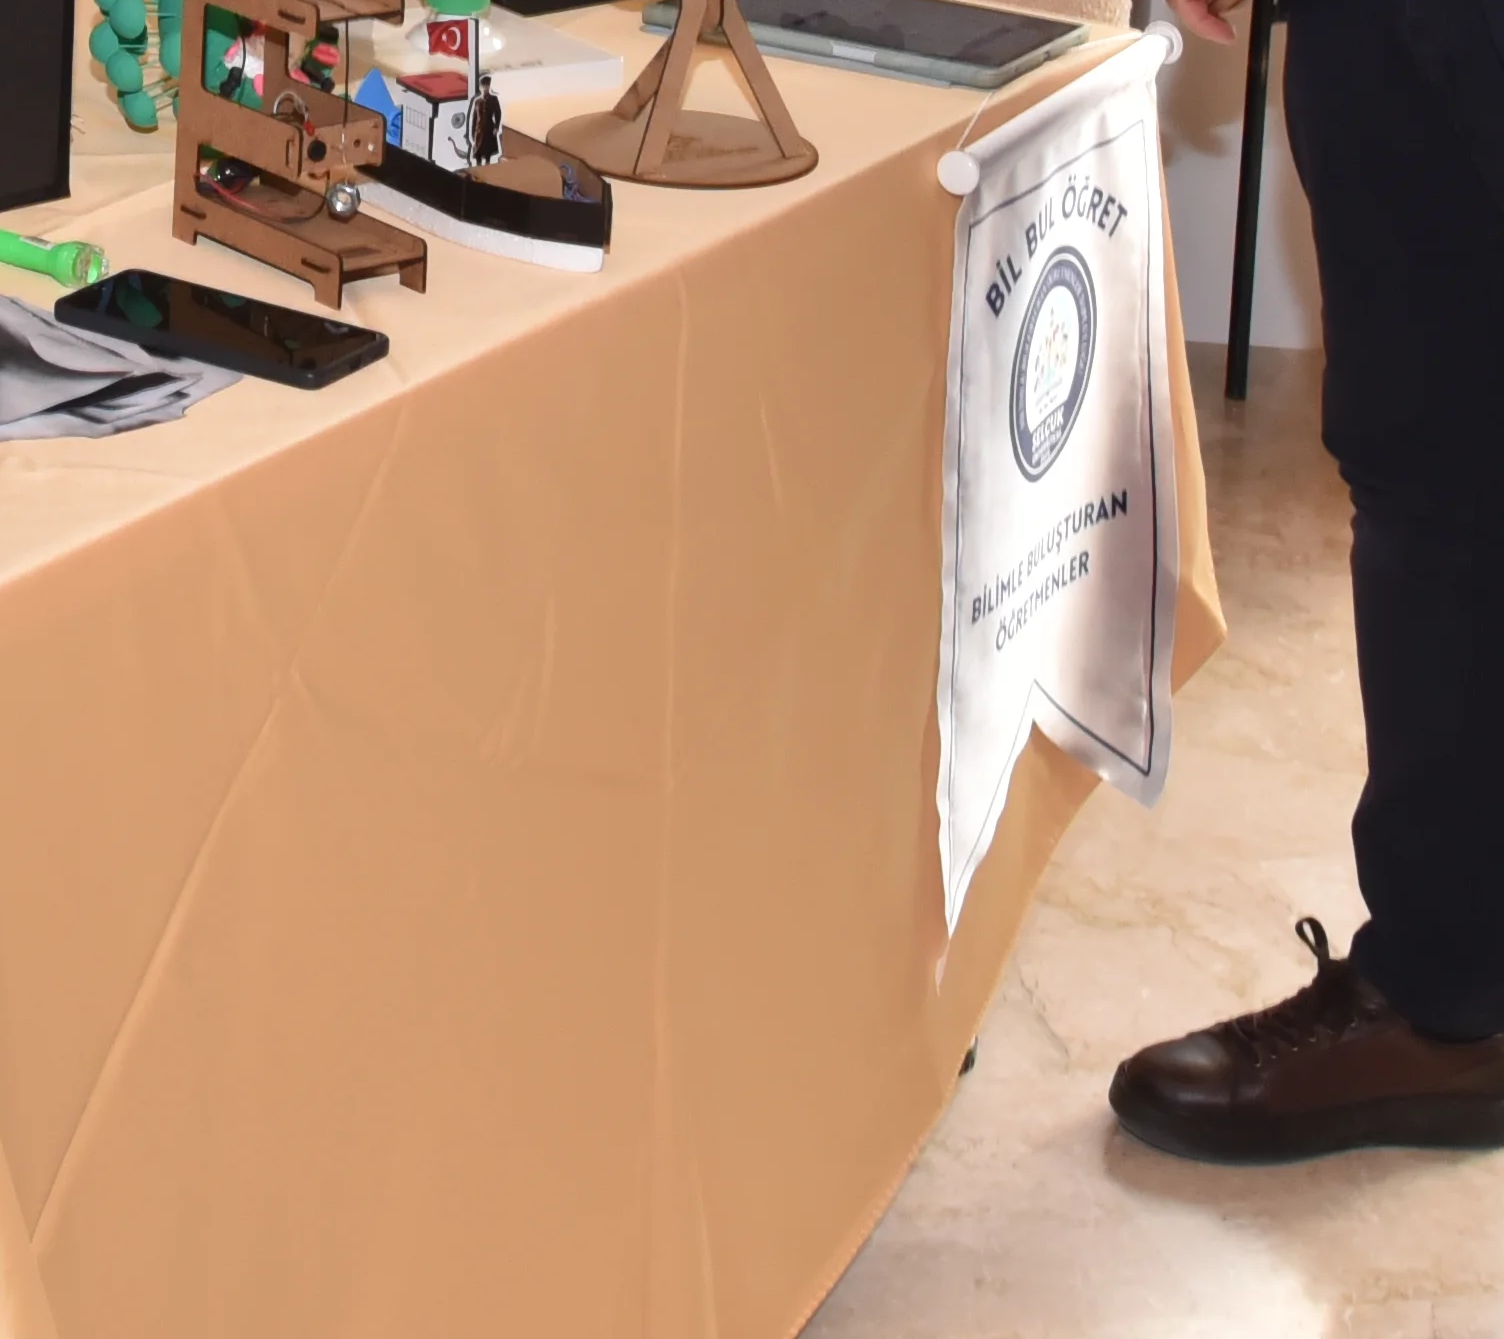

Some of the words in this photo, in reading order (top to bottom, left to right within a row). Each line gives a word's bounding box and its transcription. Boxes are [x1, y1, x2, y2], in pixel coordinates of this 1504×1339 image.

[985, 253, 1022, 319] BİL
[1025, 196, 1054, 260] BUL
[1061, 174, 1128, 239] ÖĞRET
[971, 560, 1023, 624] BİLİMLE
[1027, 488, 1127, 577] BULUŞTURAN
[995, 550, 1090, 651] ÖĞRETMENLER
